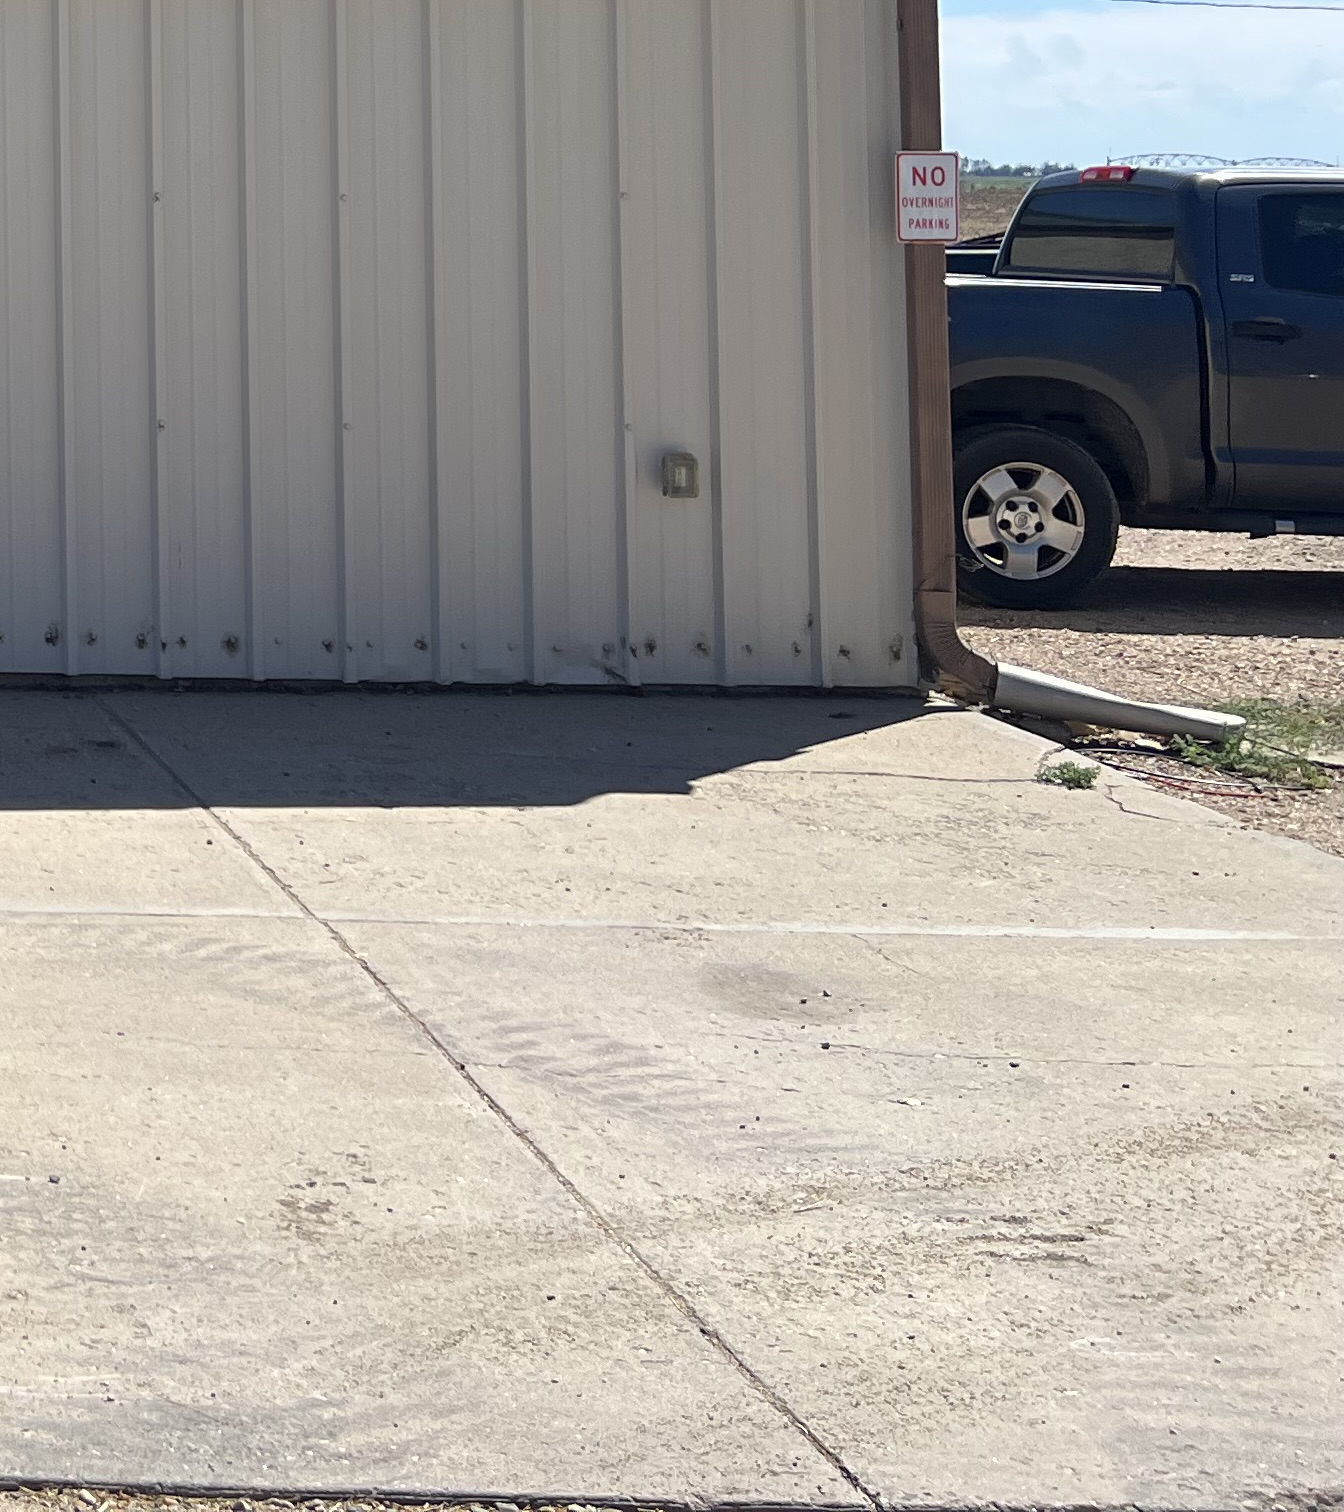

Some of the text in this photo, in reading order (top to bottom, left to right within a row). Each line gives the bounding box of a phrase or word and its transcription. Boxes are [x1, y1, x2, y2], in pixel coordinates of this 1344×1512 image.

[912, 166, 945, 186] NO
[902, 197, 953, 208] OVERNIGHT
[909, 218, 950, 229] PARKING
